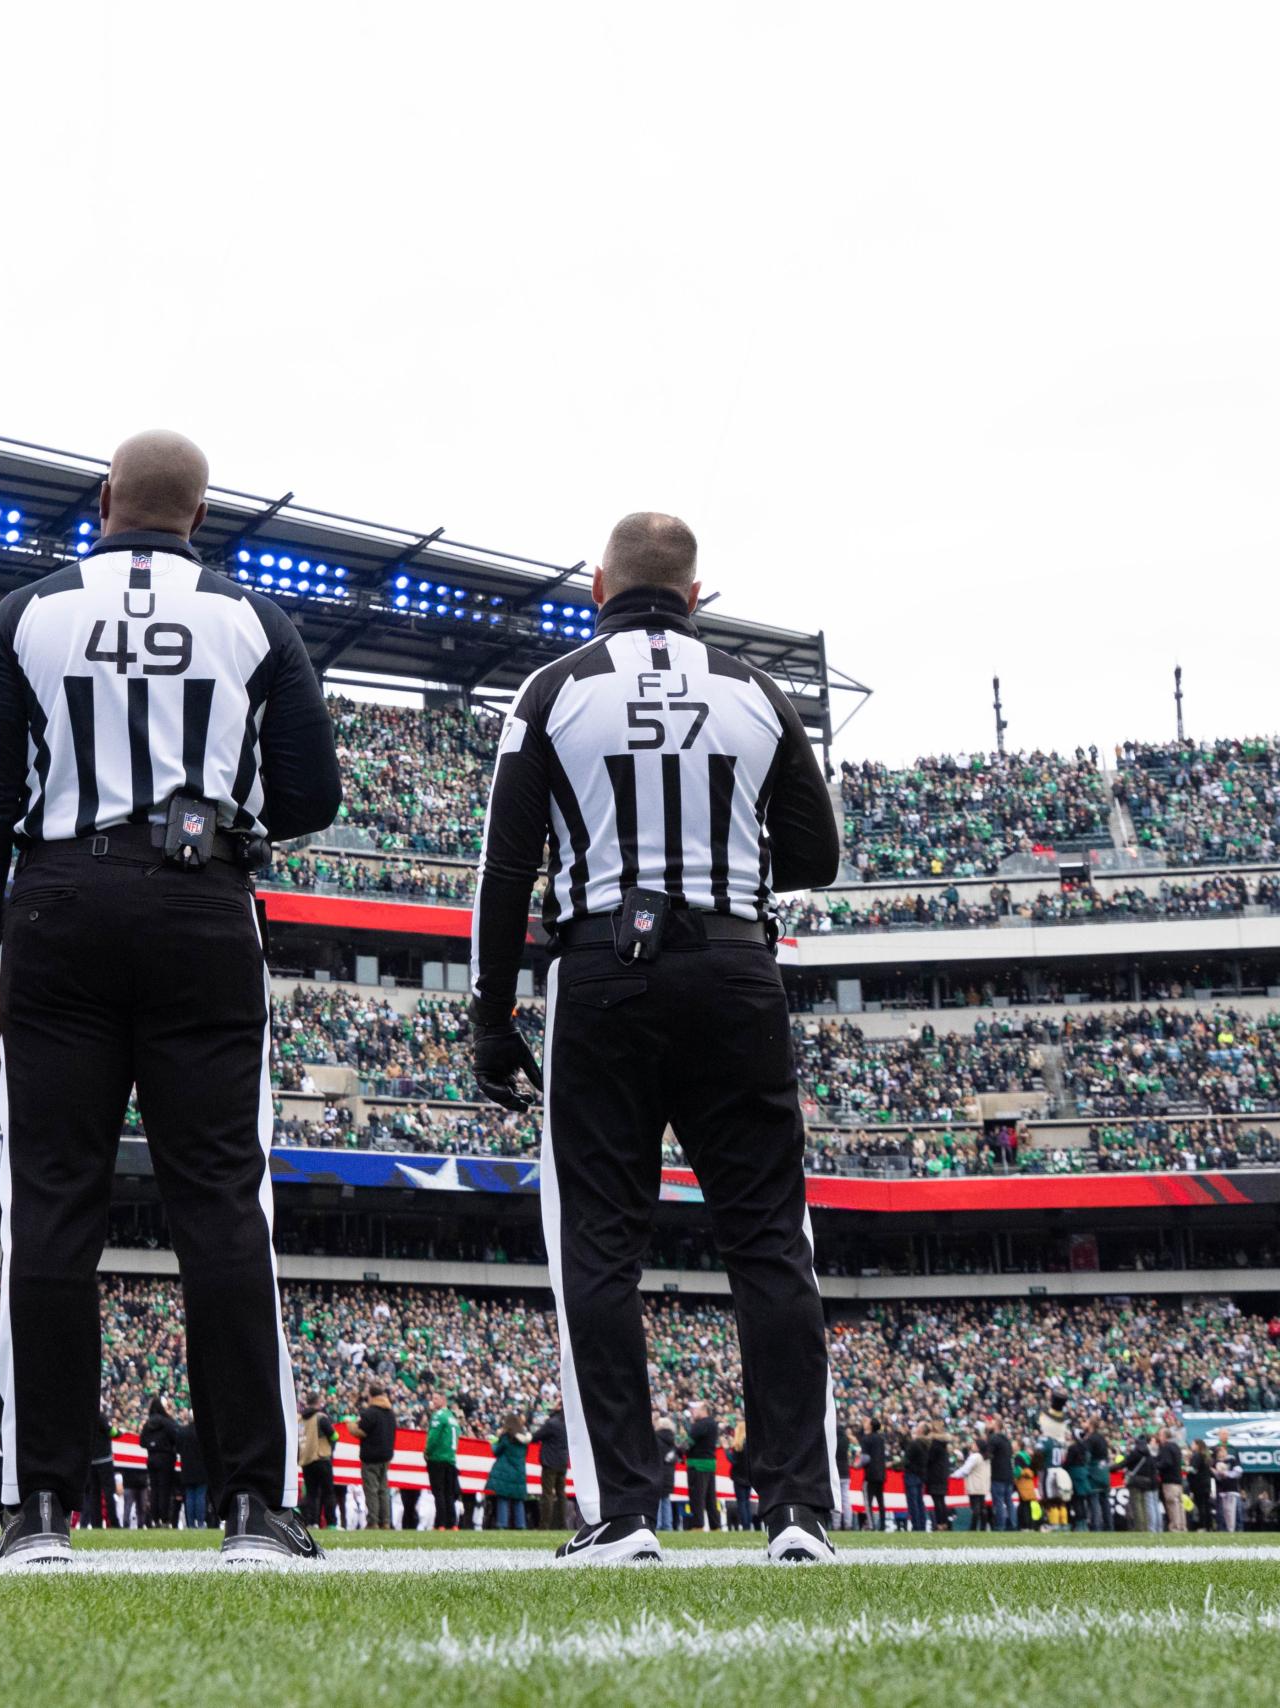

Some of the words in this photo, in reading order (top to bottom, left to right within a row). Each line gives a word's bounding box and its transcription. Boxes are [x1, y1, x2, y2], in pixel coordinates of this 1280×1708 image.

[124, 591, 155, 619] U
[84, 620, 193, 676] 49
[637, 673, 688, 698] FJ
[626, 701, 709, 750] 57
